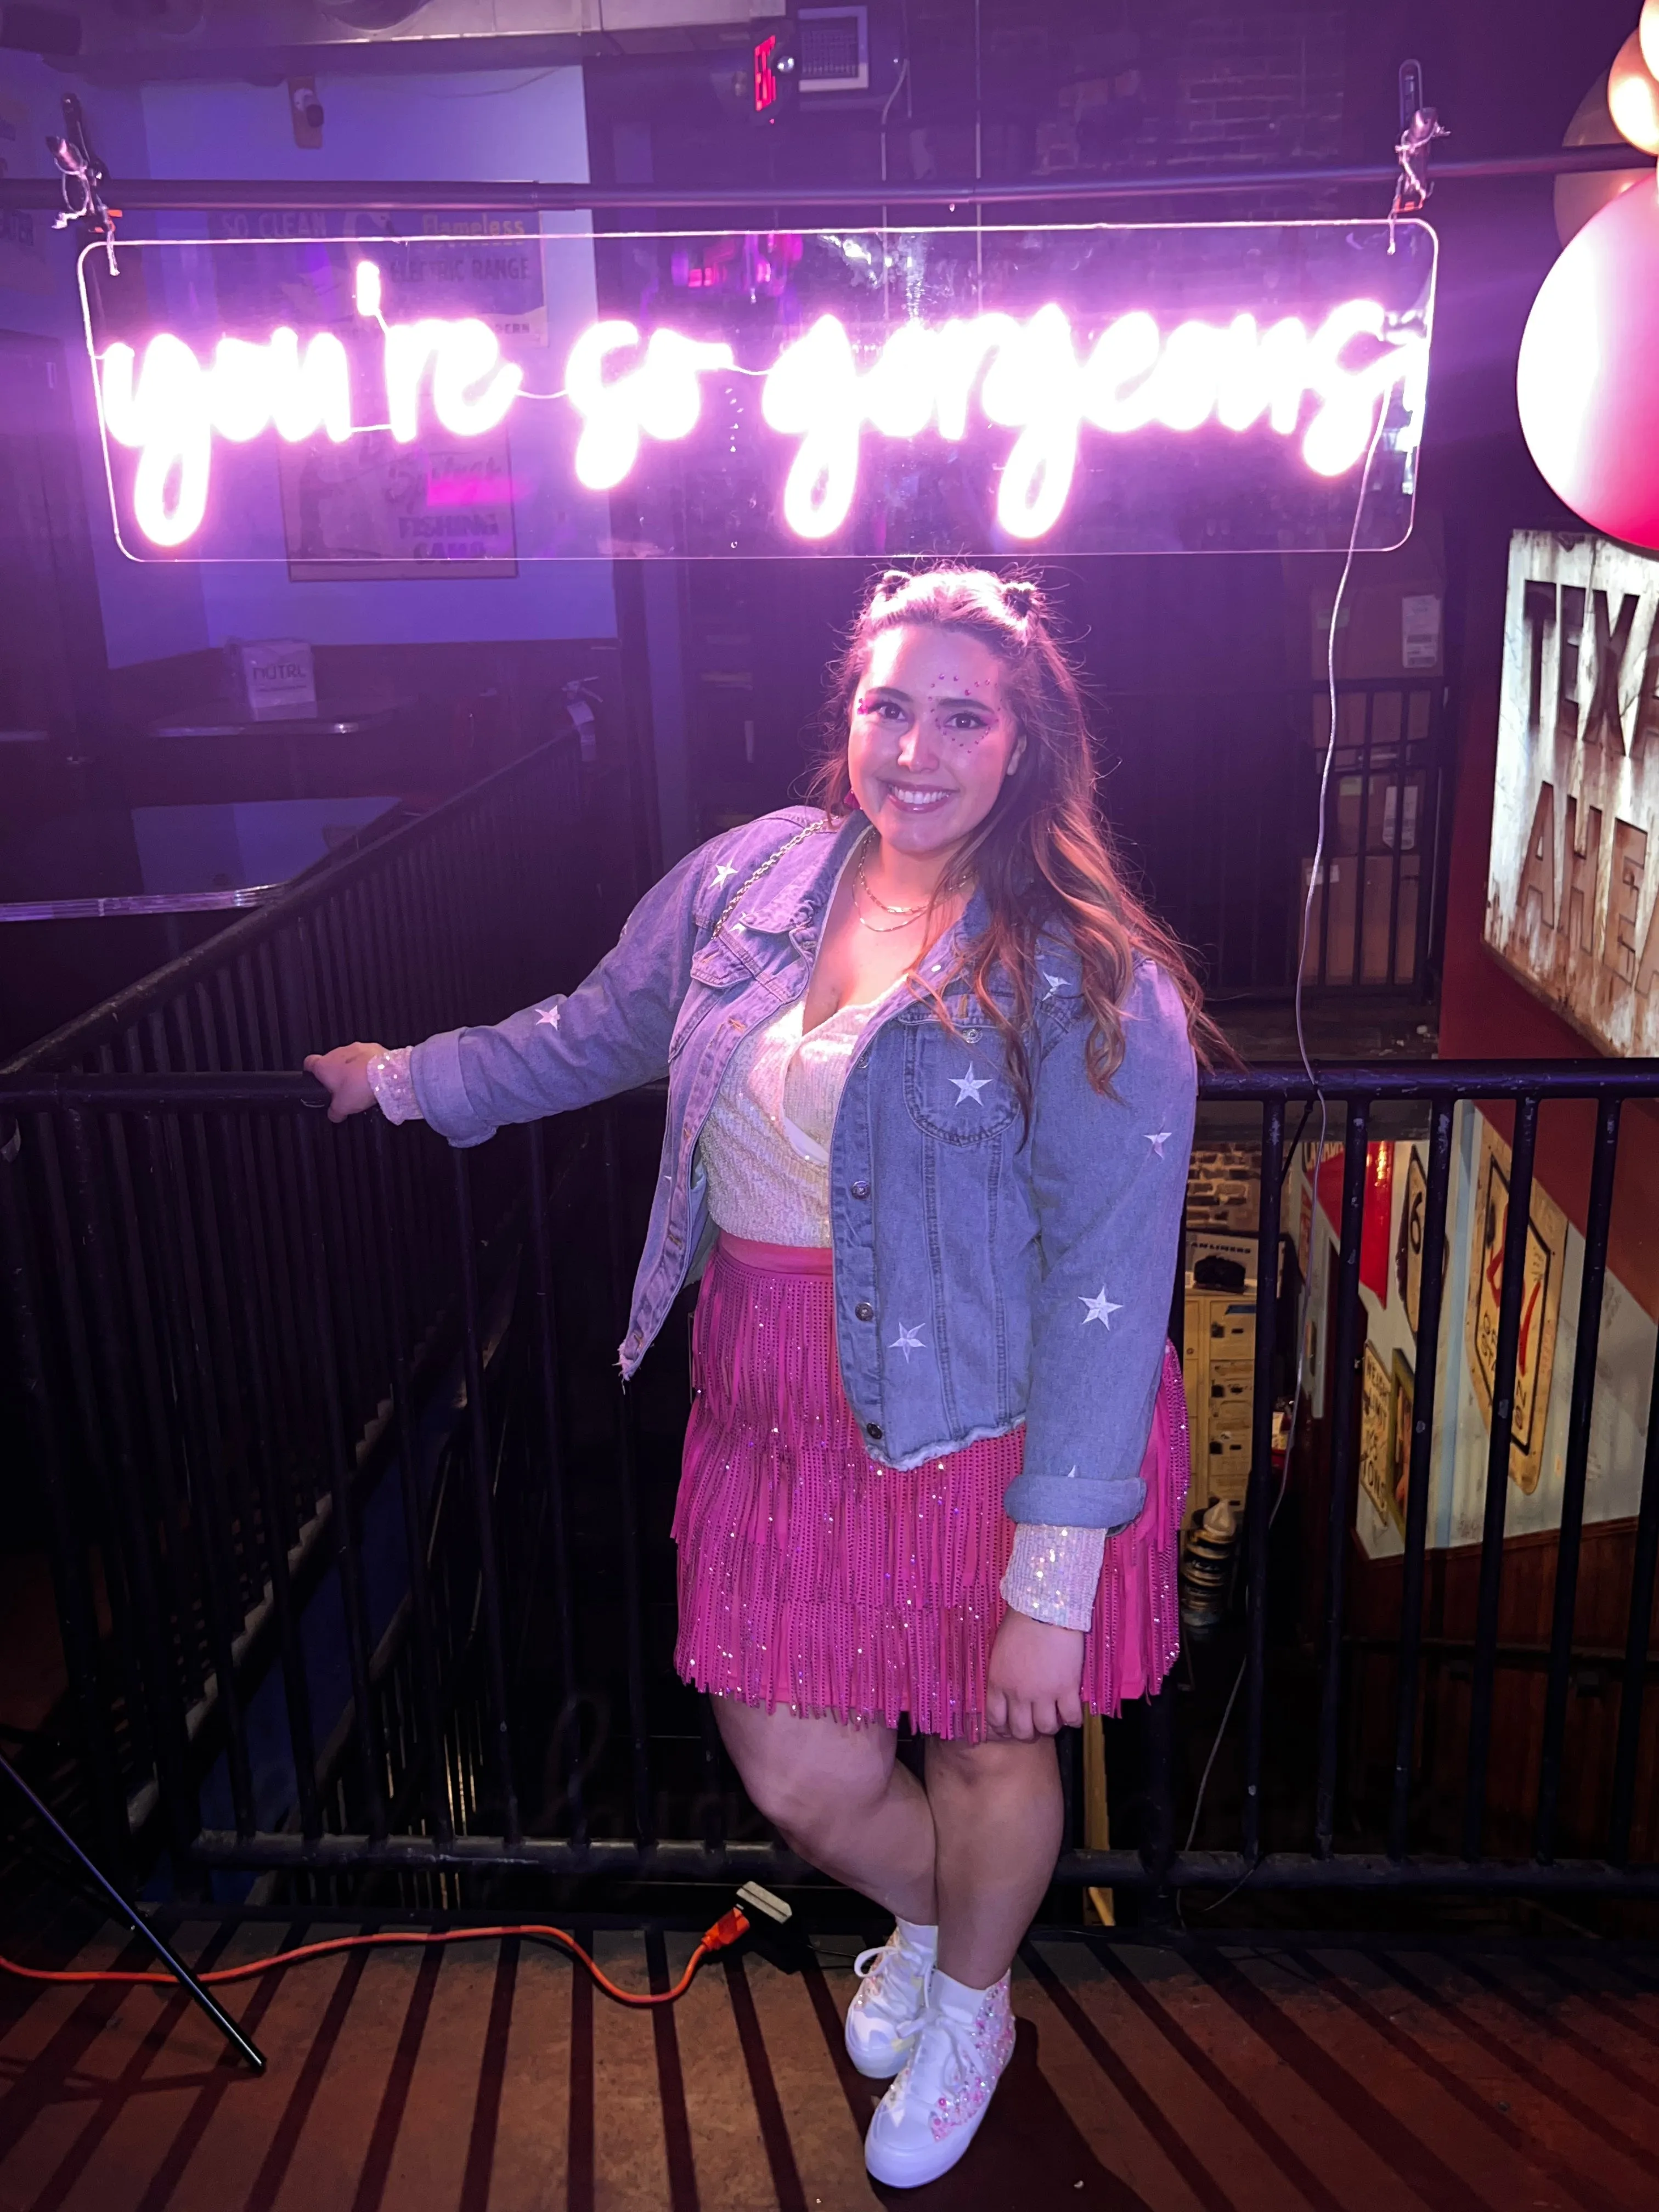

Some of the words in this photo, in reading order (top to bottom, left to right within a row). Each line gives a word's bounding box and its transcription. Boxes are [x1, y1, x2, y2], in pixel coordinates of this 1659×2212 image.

[223, 213, 249, 236] SO
[258, 212, 327, 236] CLEAN
[423, 213, 525, 237] Flameless
[390, 258, 464, 282] ELECTRIC
[472, 257, 529, 280] RANGE
[103, 261, 523, 545] you're
[566, 320, 733, 490] so
[762, 298, 1424, 539] gorgeous
